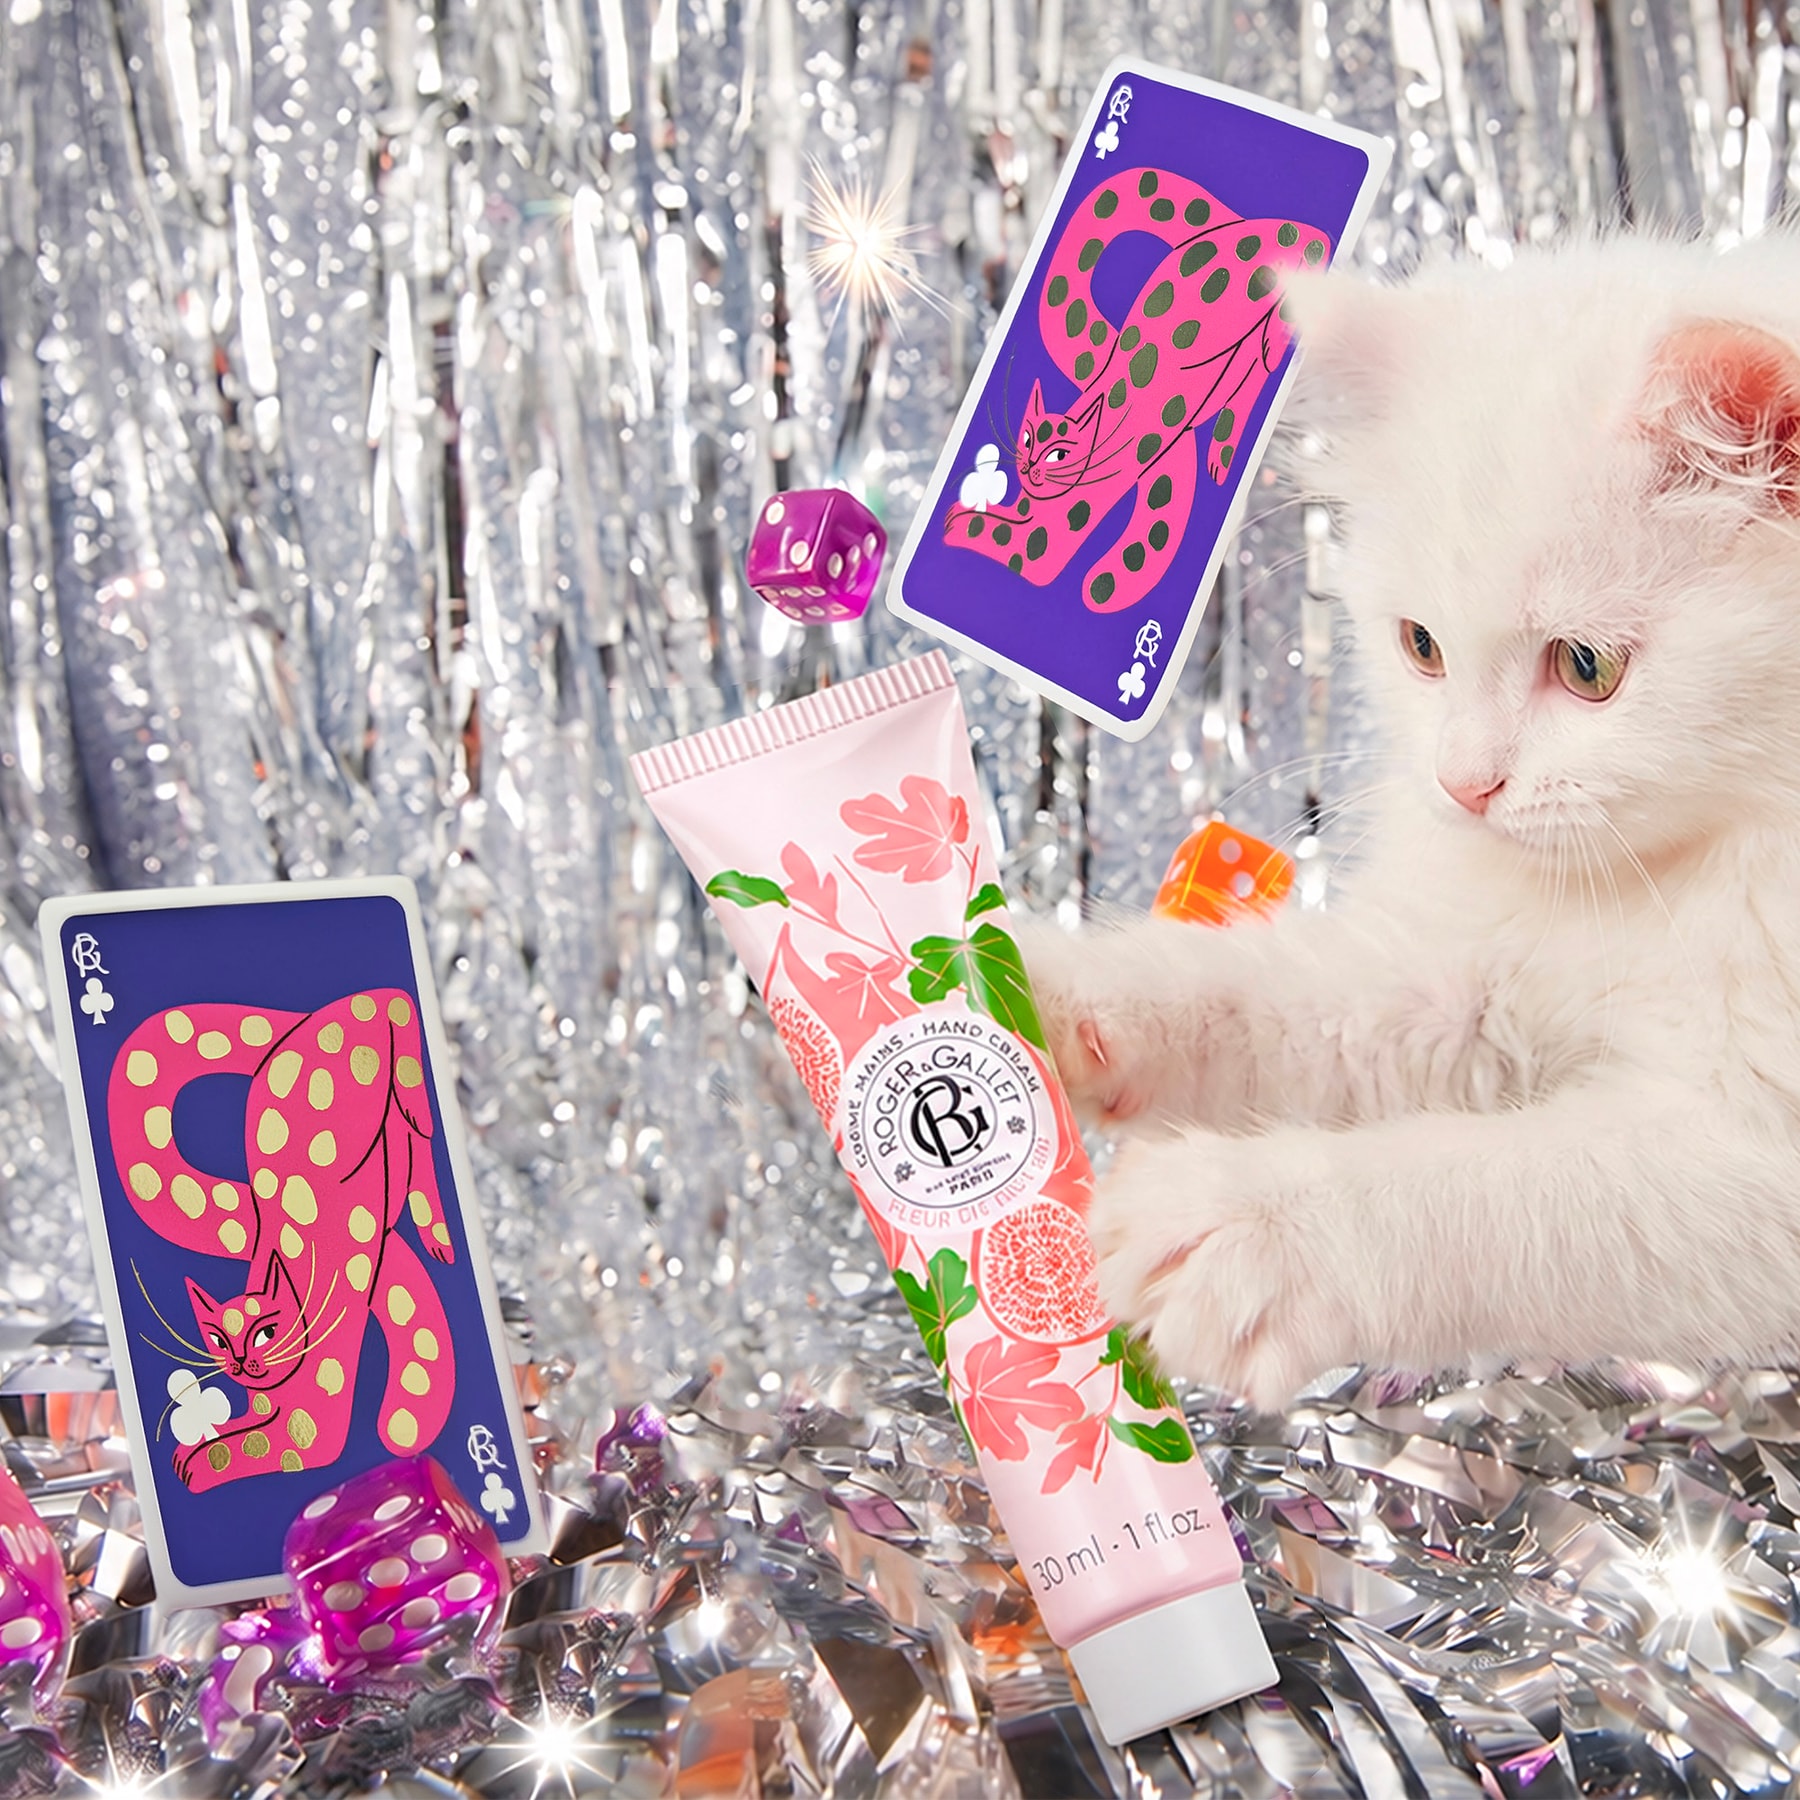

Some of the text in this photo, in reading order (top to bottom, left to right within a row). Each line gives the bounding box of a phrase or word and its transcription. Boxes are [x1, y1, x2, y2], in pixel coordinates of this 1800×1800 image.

[922, 1020, 984, 1038] HAND
[888, 1198, 951, 1229] FLEUR
[1032, 1556, 1064, 1591] 30
[1066, 1534, 1105, 1576] ml
[1122, 1522, 1141, 1550] 1
